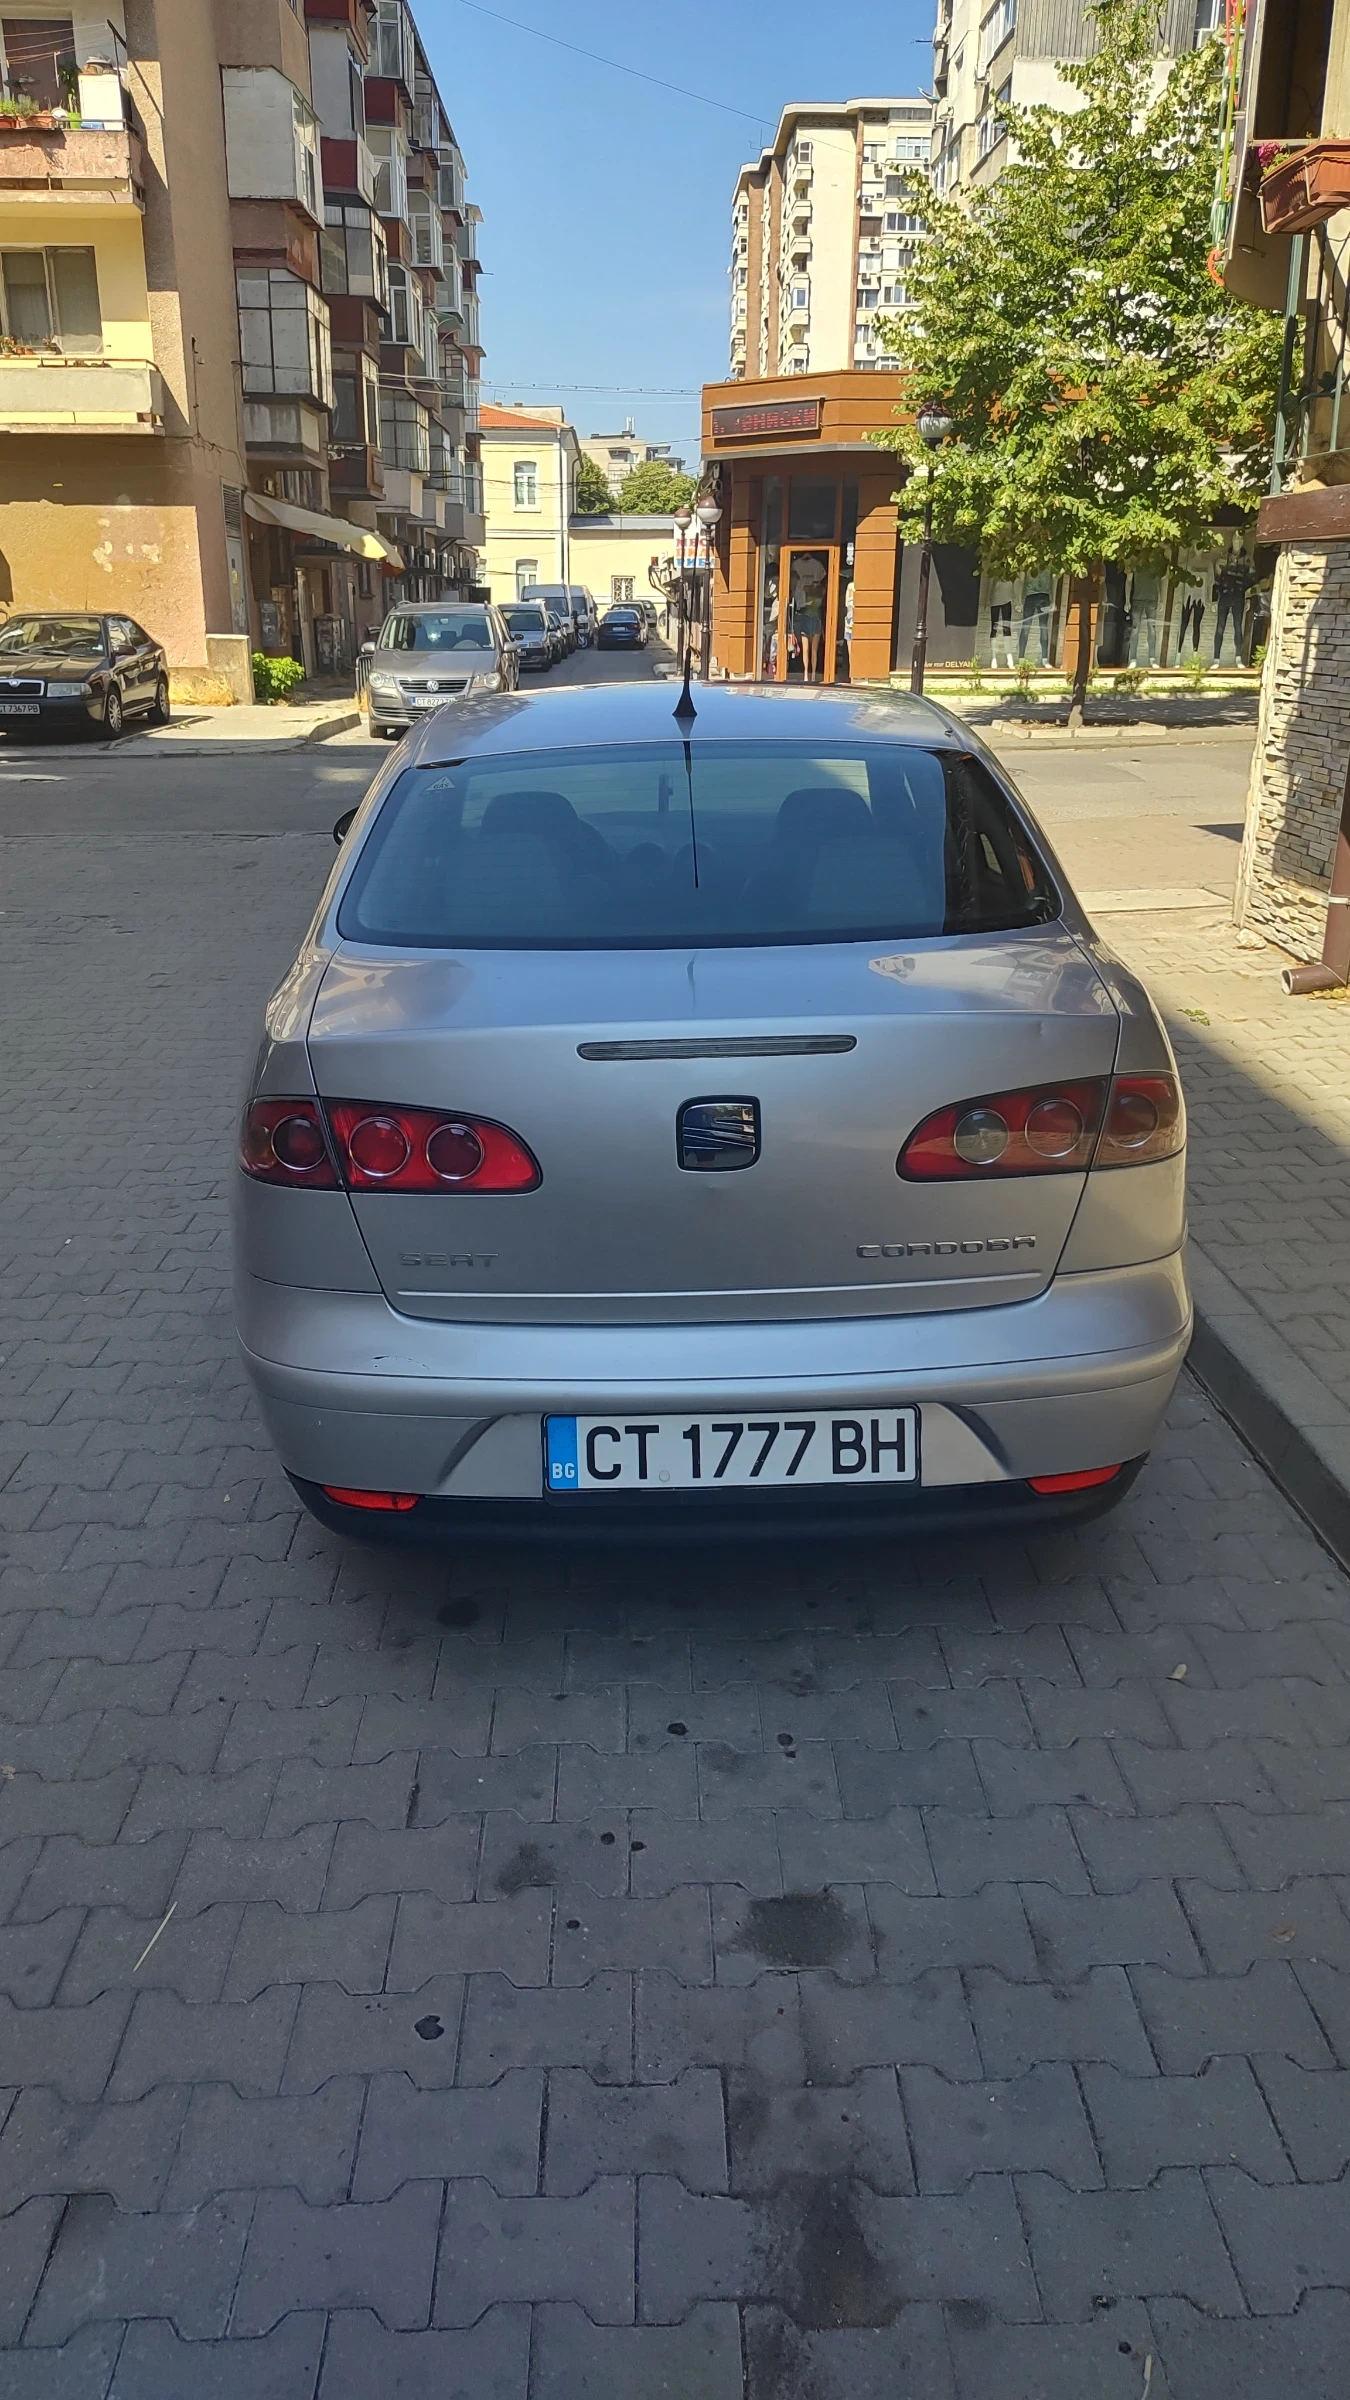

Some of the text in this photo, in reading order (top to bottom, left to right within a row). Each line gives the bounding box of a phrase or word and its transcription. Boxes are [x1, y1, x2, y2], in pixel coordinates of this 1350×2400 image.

[856, 1235, 1036, 1258] CORDOBA
[399, 1252, 499, 1267] SEAT
[586, 1418, 906, 1480] CT 1777 BH
[552, 1462, 575, 1479] BG
